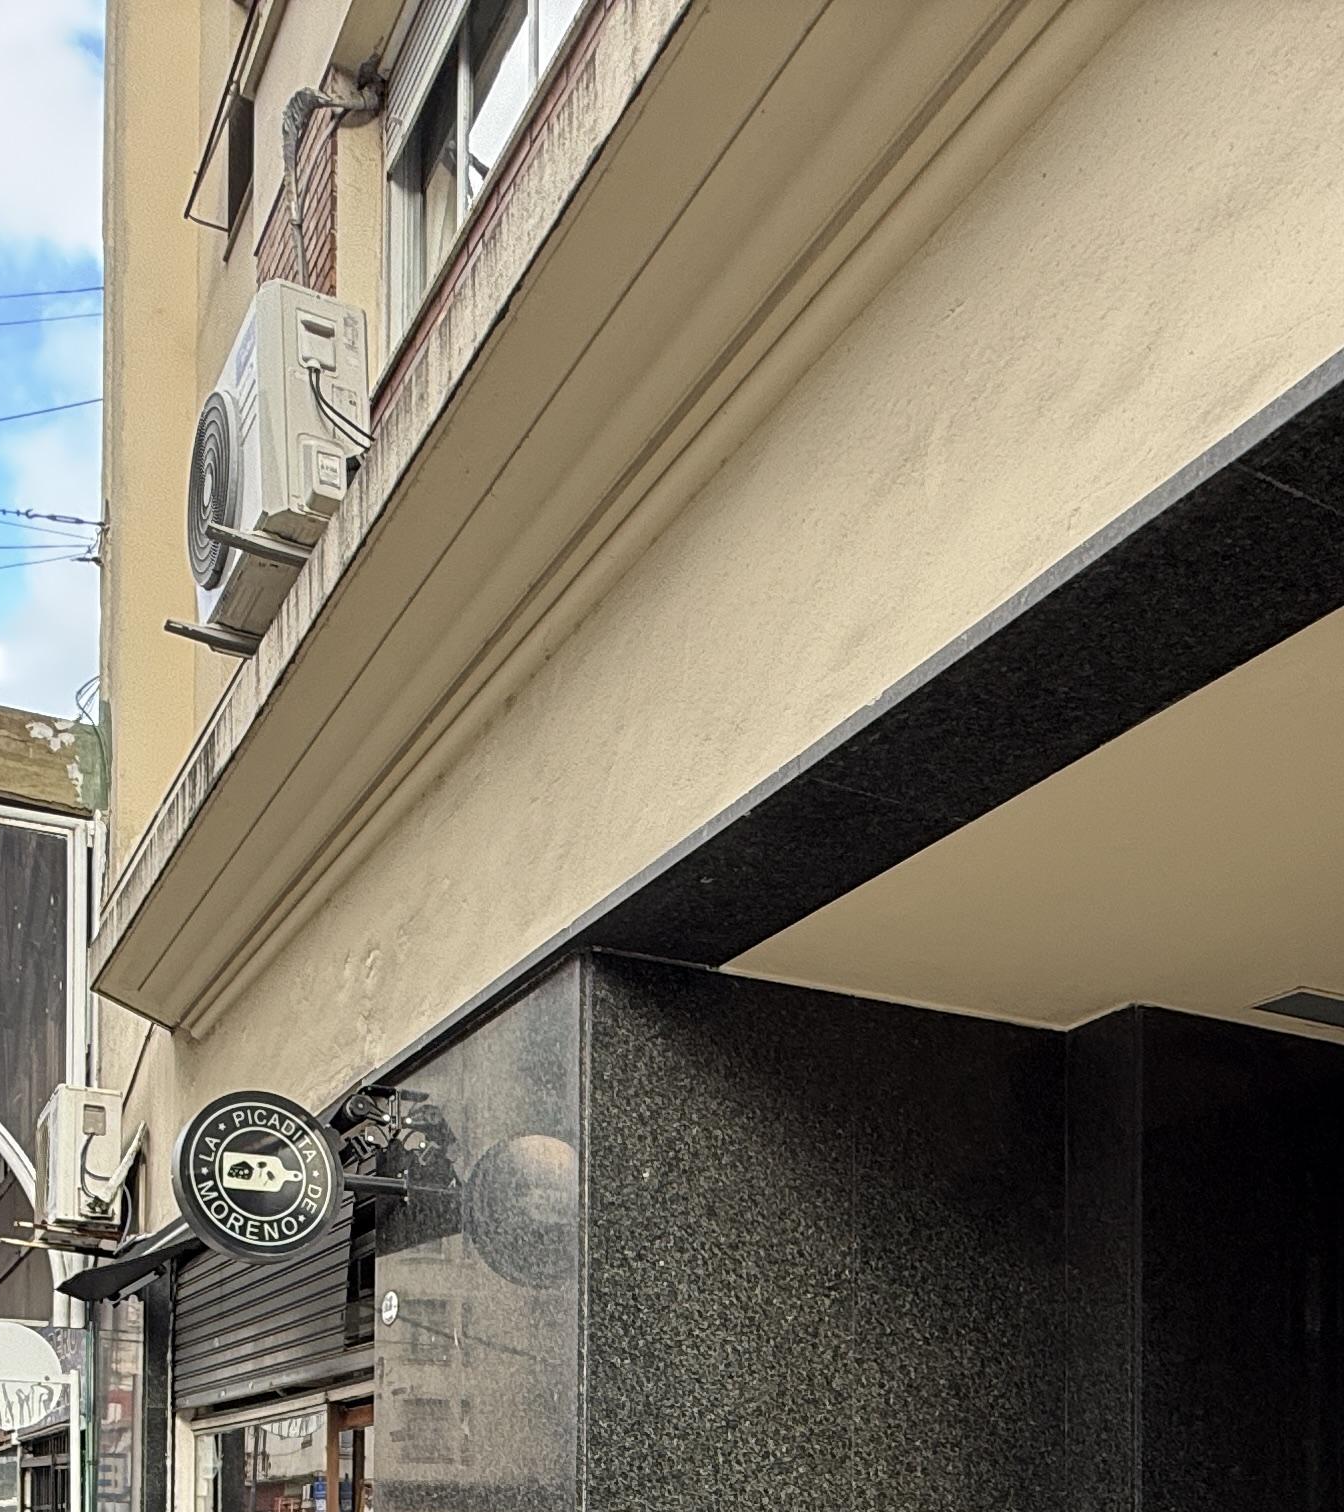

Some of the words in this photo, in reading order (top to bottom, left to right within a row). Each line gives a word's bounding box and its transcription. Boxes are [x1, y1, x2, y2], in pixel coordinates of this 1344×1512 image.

[198, 1135, 221, 1163] LA
[232, 1108, 318, 1164] PICADITA
[197, 1179, 299, 1241] MORENO
[300, 1183, 322, 1215] DE
